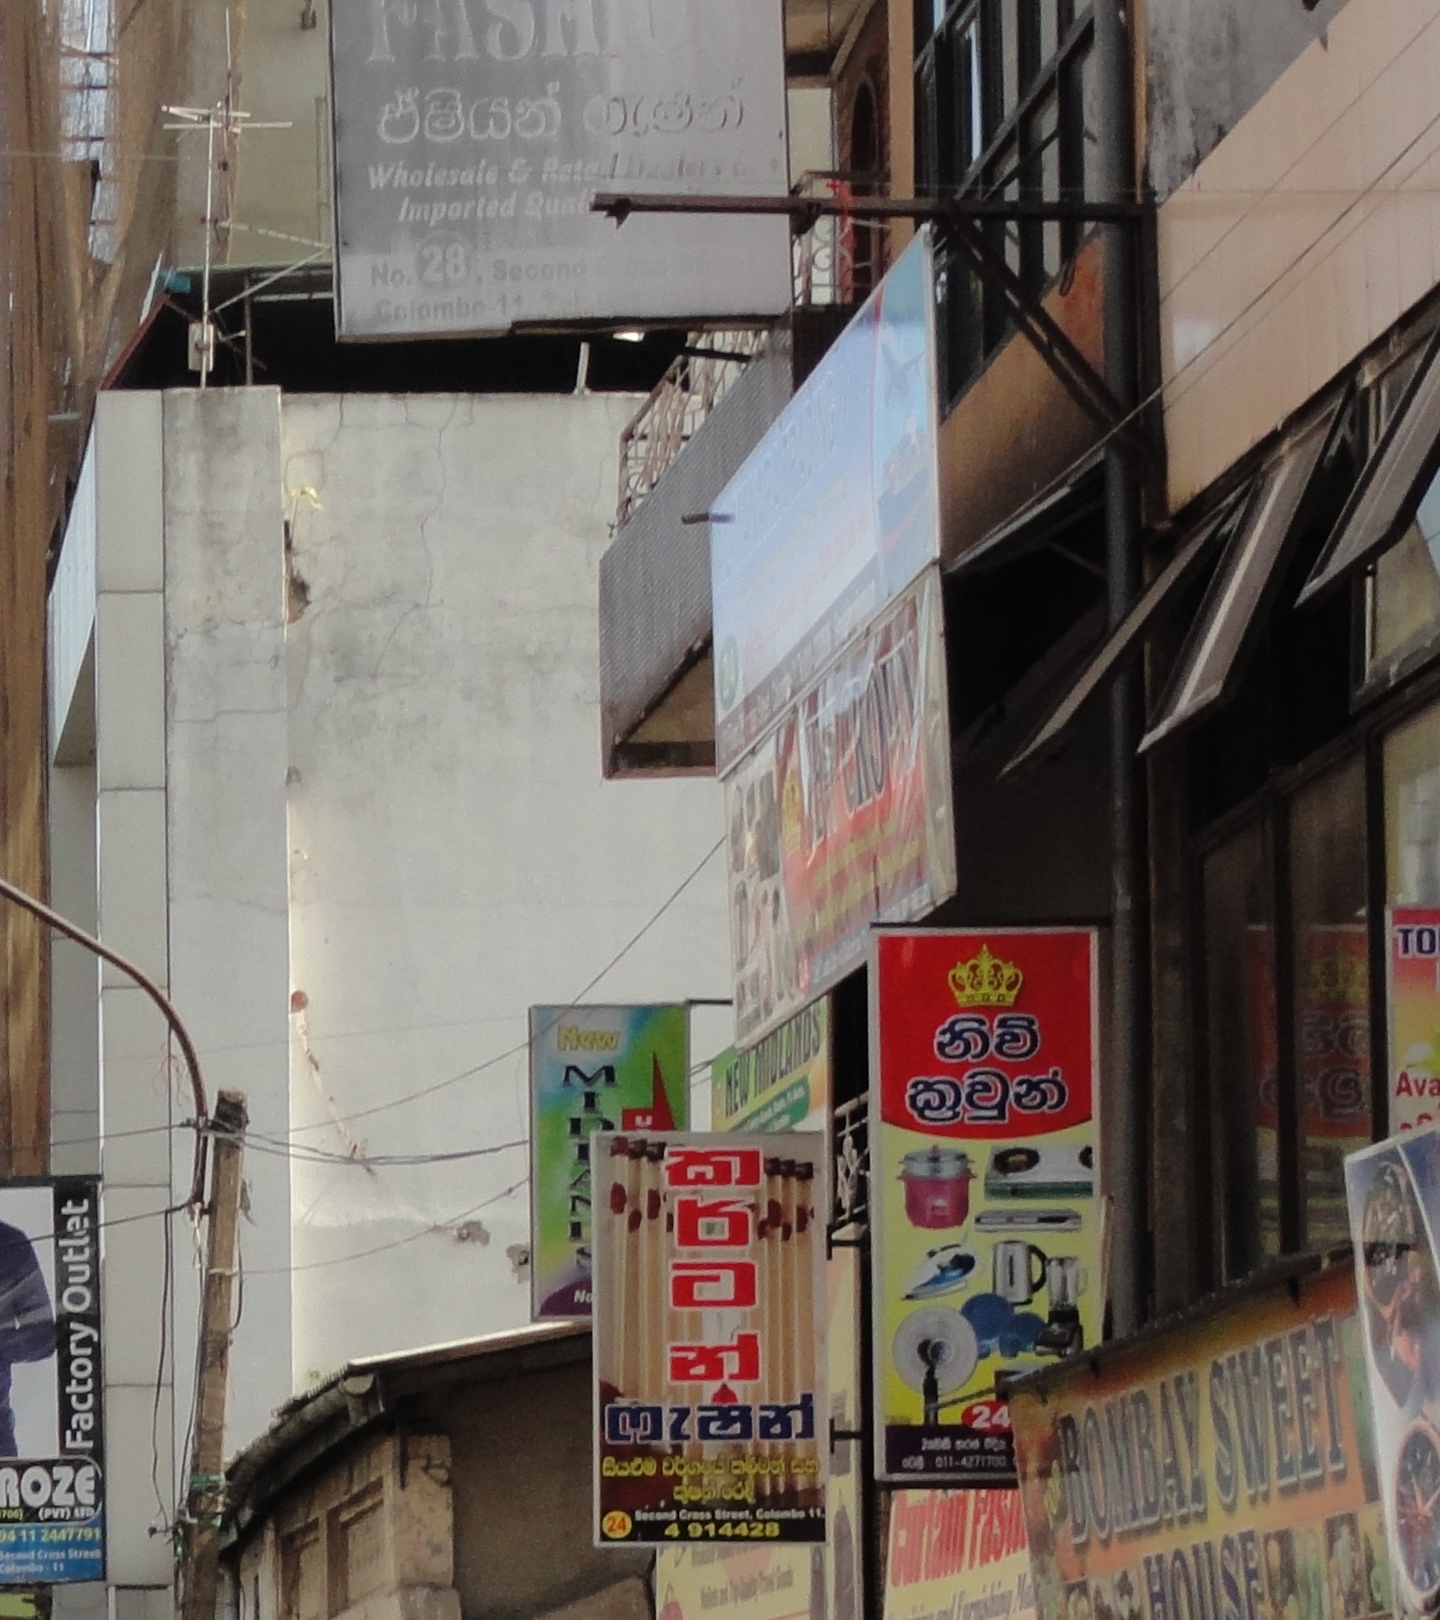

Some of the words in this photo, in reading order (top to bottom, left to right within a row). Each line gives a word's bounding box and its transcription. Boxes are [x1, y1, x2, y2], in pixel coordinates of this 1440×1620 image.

[368, 159, 499, 190] Wholesale
[398, 197, 514, 226] Imported
[423, 242, 467, 283] 28
[557, 1025, 619, 1051] New
[58, 1198, 91, 1314] Outlet
[65, 1320, 98, 1450] Factory
[971, 1404, 1011, 1429] 24
[1058, 1371, 1208, 1546] BOMBAY
[1208, 1315, 1349, 1516] SWEET
[38, 1506, 71, 1520] (PVT)
[605, 1515, 628, 1534] 24
[635, 1508, 678, 1521] Second
[664, 1521, 680, 1538] 4
